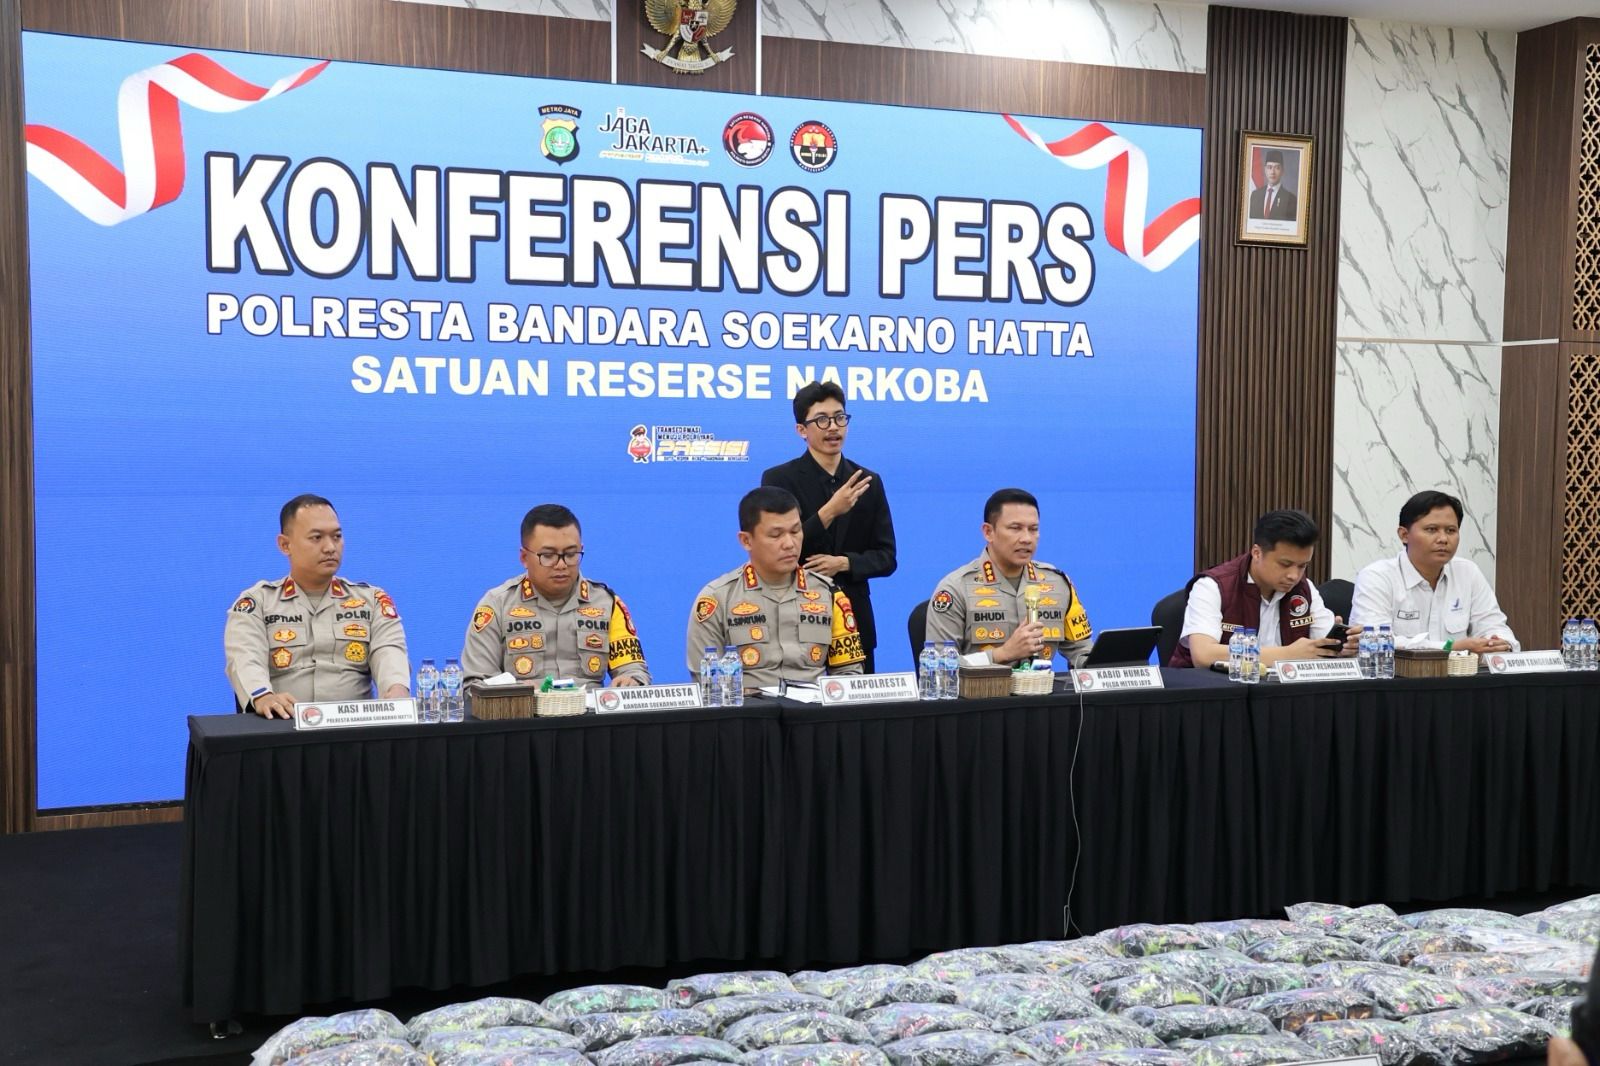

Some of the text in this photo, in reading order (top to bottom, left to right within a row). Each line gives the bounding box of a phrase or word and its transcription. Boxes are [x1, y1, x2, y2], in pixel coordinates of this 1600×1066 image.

[599, 114, 651, 135] JAGA
[204, 151, 1096, 307] KONFERENSI PERS
[207, 293, 1095, 358] POLRESTA BANDARA SOEKARNO HATTA
[351, 355, 989, 403] SATUAN RESERSE NARKOBA
[656, 441, 750, 456] PRESISI
[264, 614, 303, 625] SEPTIAN
[336, 610, 371, 621] POLRI
[800, 614, 832, 625] POLRI
[974, 612, 1005, 622] BHUDI
[1038, 610, 1062, 620] POLRI
[507, 620, 542, 632] JOKO
[577, 619, 609, 631] POLRI
[1097, 668, 1151, 679] KABID HUMAS
[850, 677, 907, 690] KAPOLRESTA
[621, 687, 694, 700] WAKAPOLRESTA
[338, 702, 395, 714] KASI HUMAS
